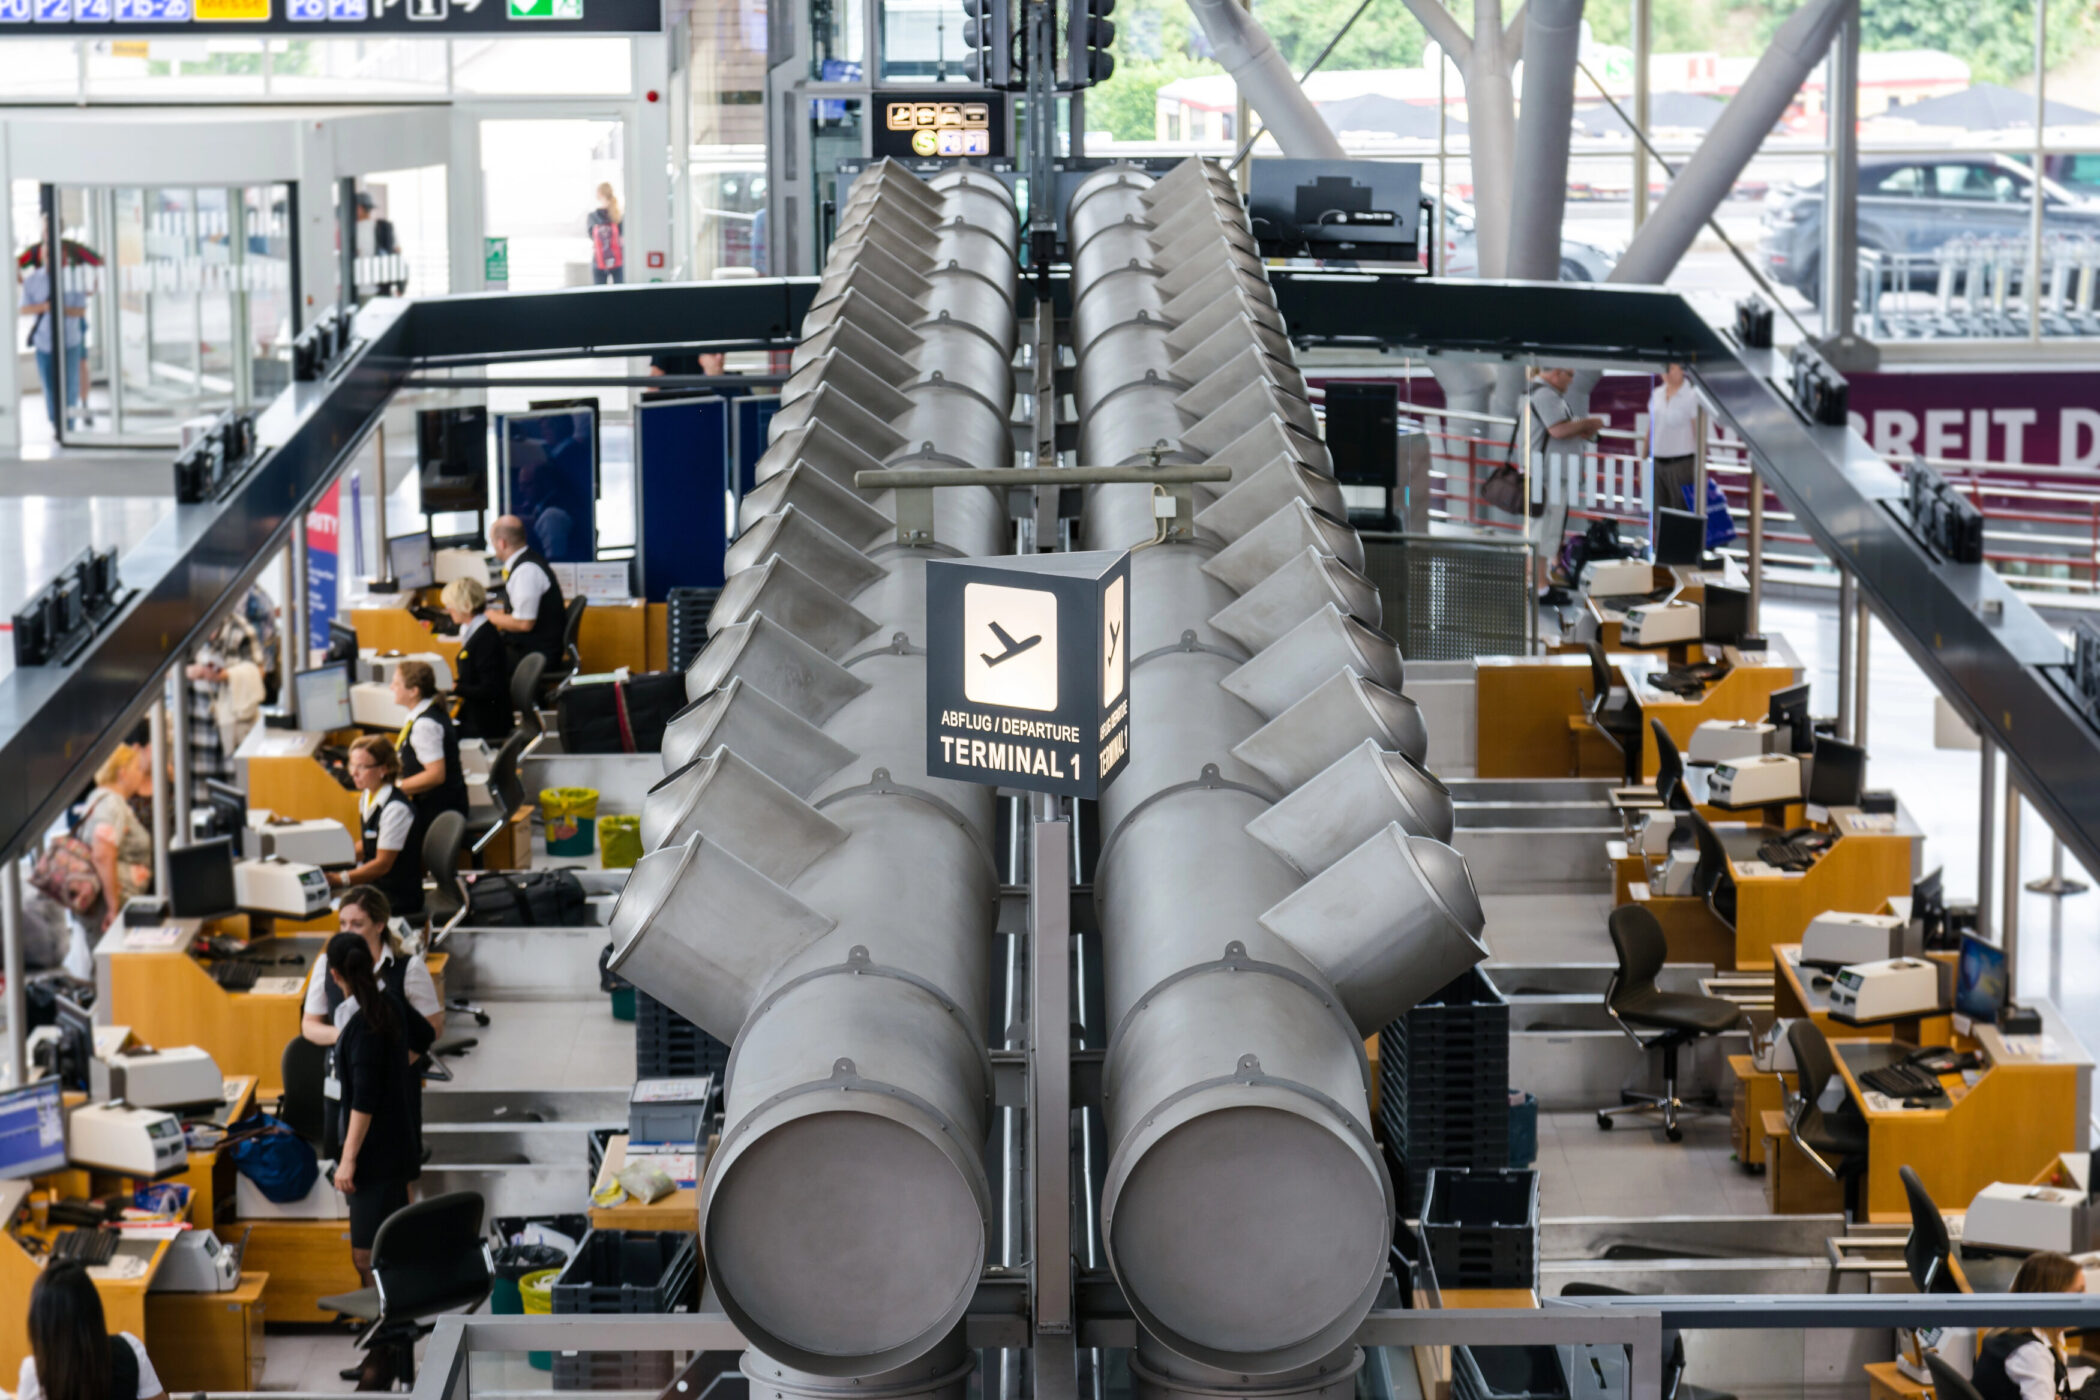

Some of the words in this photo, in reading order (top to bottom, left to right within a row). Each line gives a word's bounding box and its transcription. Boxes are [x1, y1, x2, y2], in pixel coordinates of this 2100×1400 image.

[941, 710, 992, 731] ABFLUG
[1002, 718, 1080, 743] DEPARTURE
[940, 736, 1064, 779] TERMINAL
[1070, 754, 1080, 781] 1
